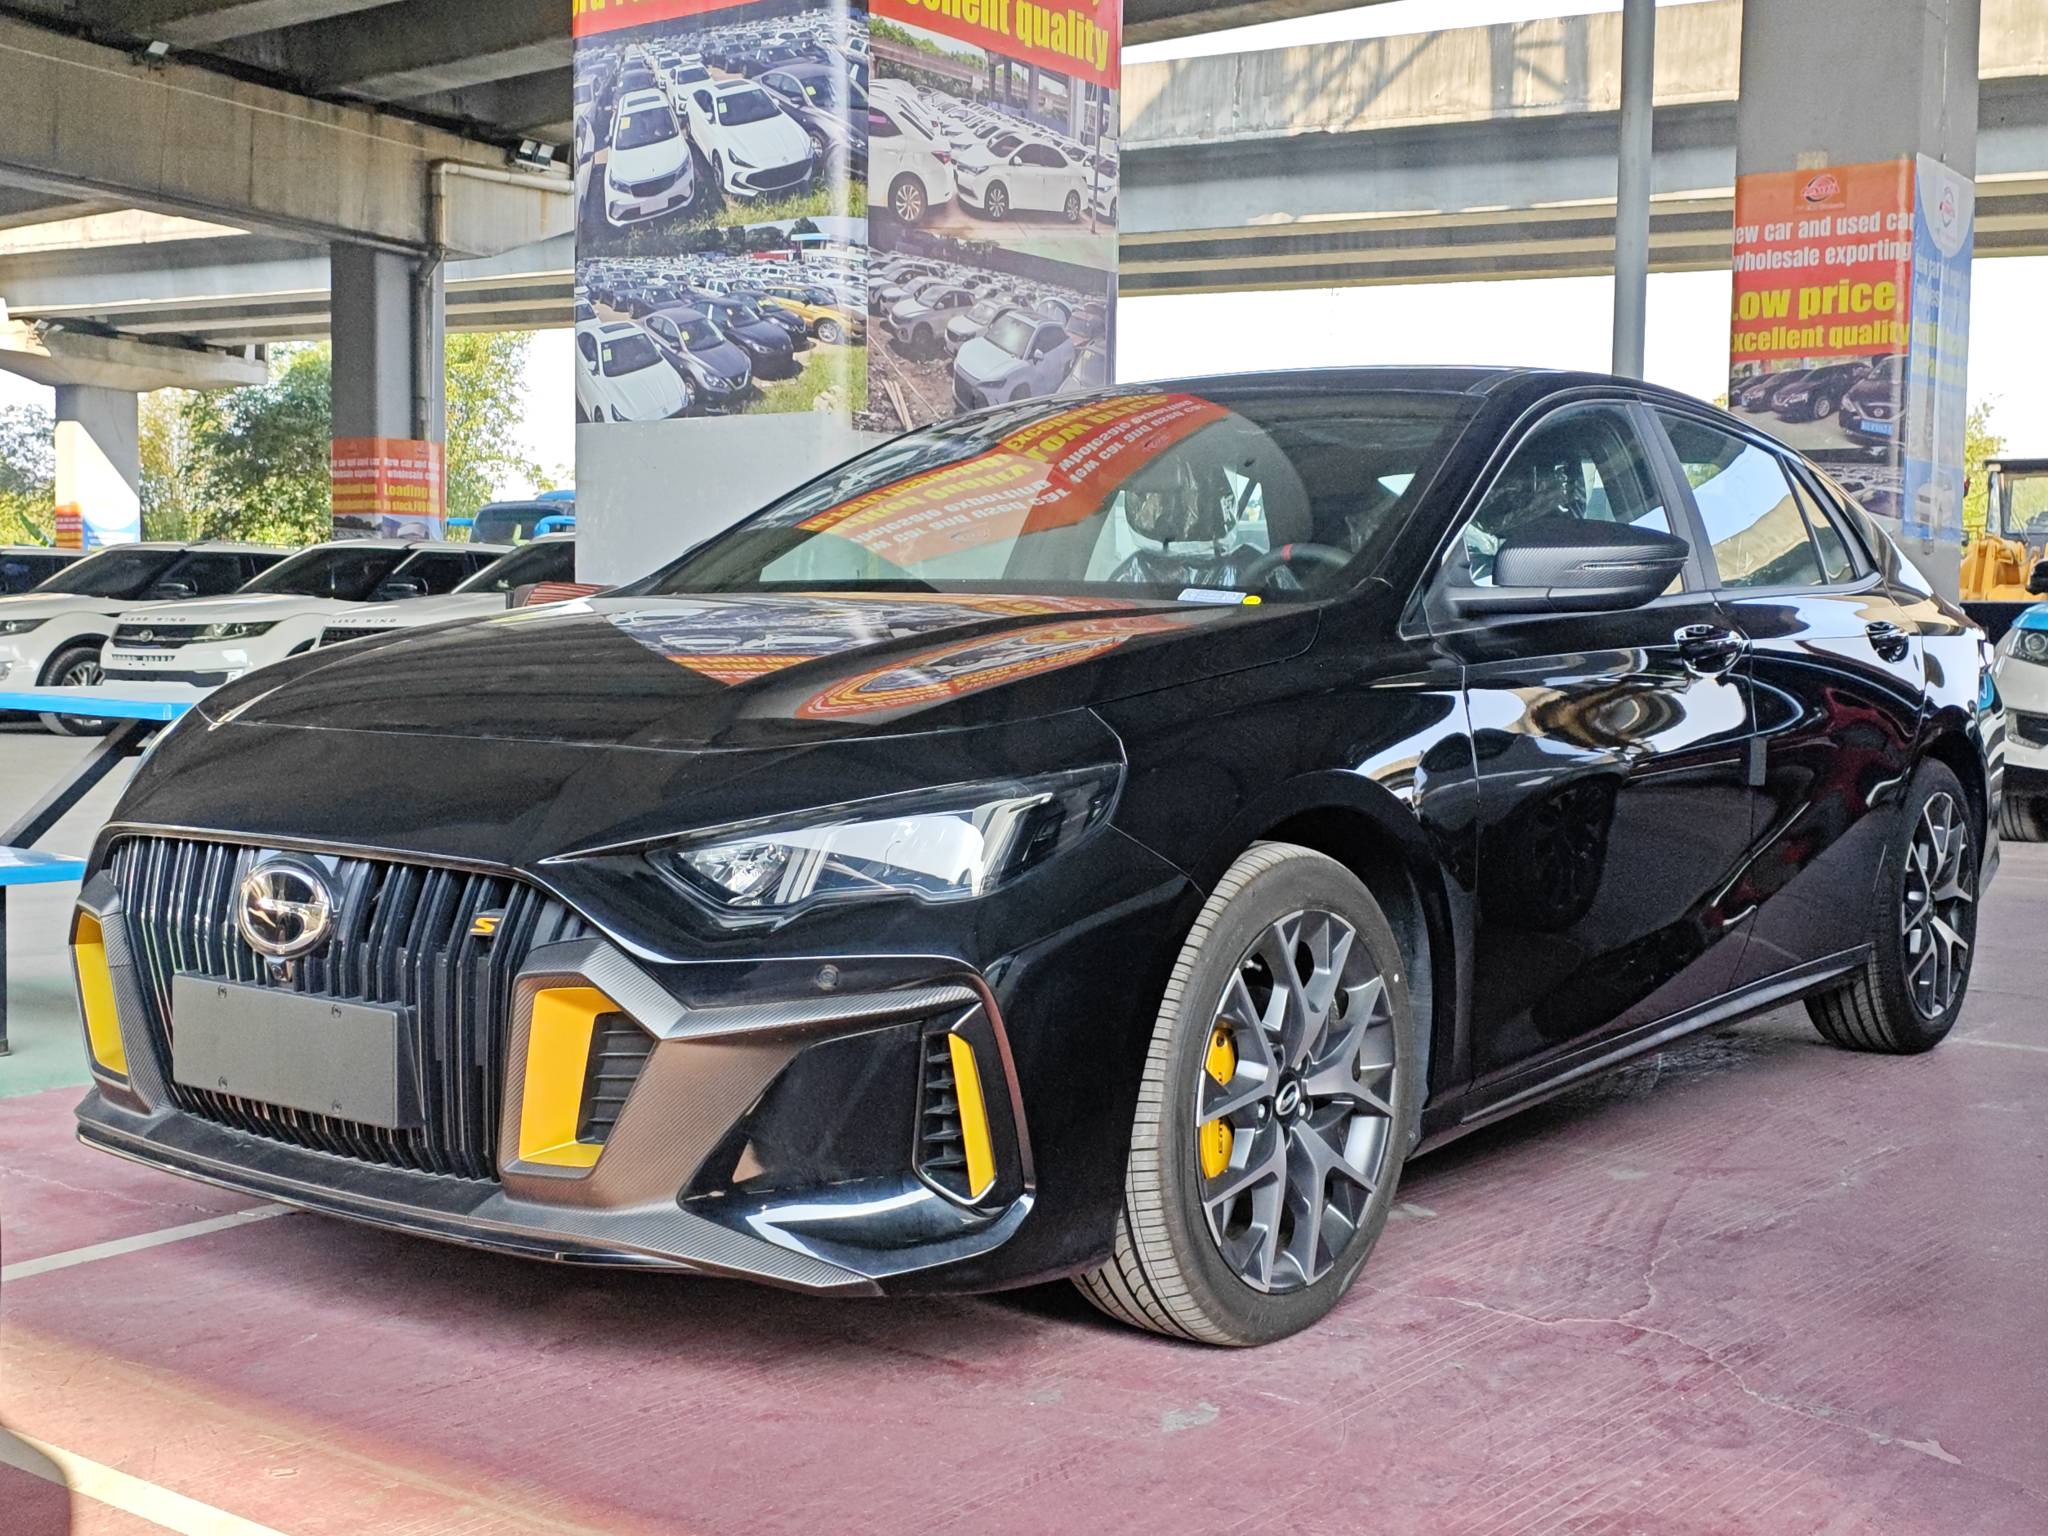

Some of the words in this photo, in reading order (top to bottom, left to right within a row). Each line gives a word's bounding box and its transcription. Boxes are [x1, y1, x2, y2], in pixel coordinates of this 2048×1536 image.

[1015, 0, 1109, 72] quality
[1735, 225, 1759, 244] ew
[1764, 222, 1793, 241] car
[1798, 216, 1832, 239] and
[1836, 211, 1881, 235] used
[1825, 239, 1912, 267] exporting
[1732, 325, 1824, 353] xcellent
[1829, 319, 1911, 349] quality
[383, 482, 428, 499] Loading
[470, 917, 501, 933] S
